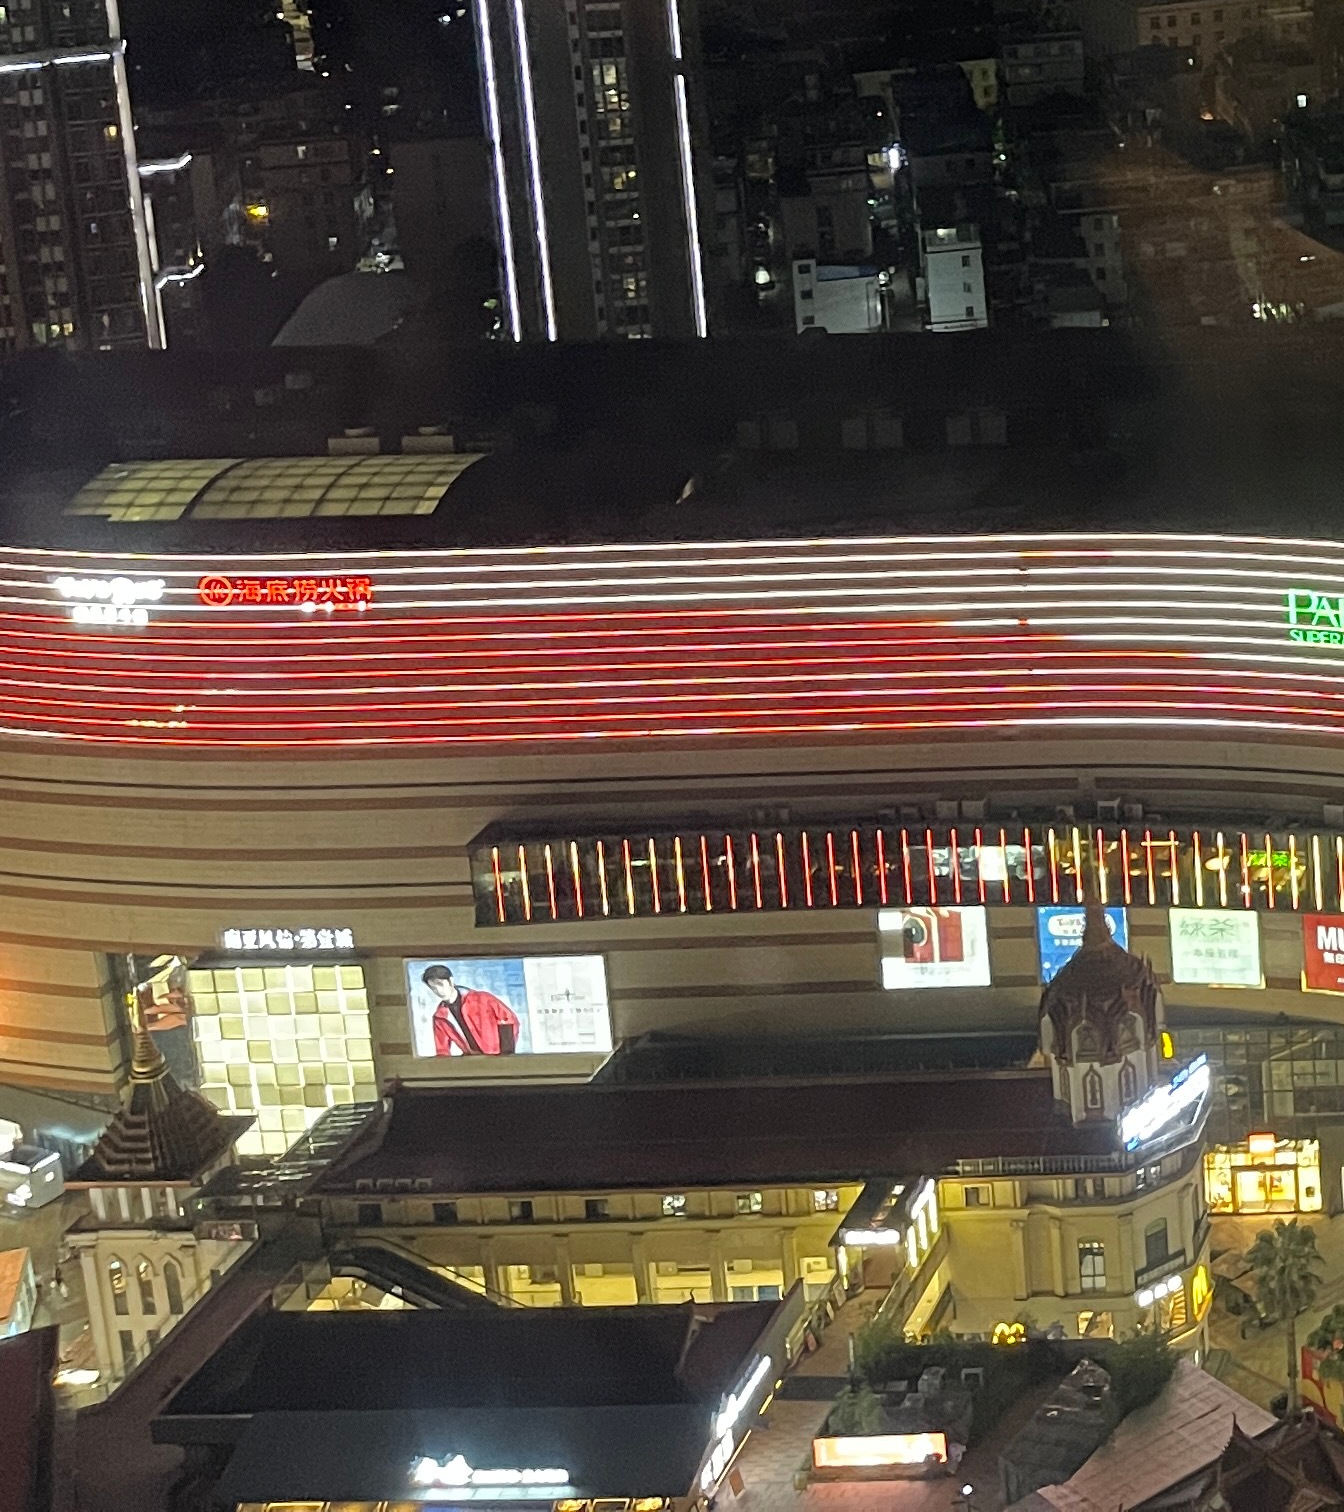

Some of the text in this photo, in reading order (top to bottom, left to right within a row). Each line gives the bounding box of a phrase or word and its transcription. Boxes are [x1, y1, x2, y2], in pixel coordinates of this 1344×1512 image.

[238, 576, 373, 604] 海底捞火锅
